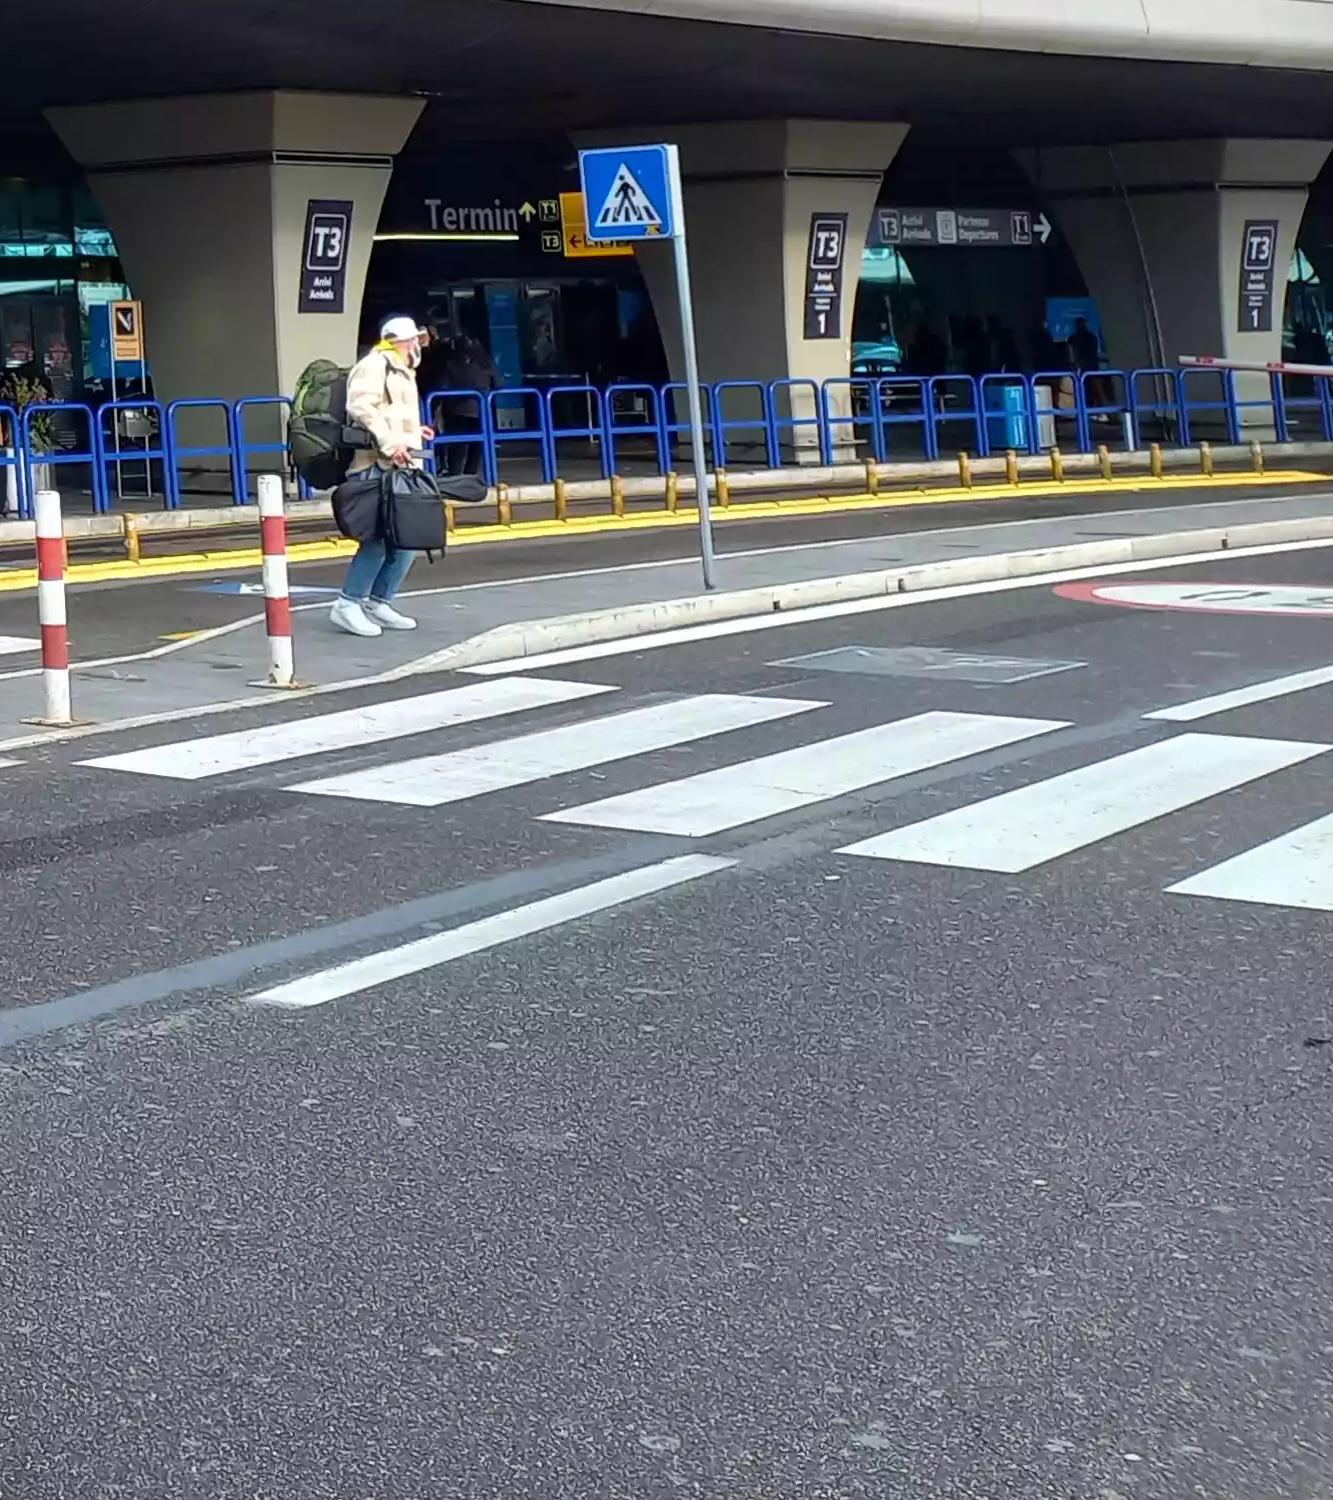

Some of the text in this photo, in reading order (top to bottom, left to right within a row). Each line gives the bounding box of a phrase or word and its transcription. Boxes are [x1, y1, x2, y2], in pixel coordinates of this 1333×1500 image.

[881, 217, 898, 236] T3
[314, 226, 342, 258] T3
[542, 236, 560, 248] T3
[817, 231, 839, 258] T3
[1249, 236, 1271, 260] T3
[817, 312, 826, 334] 1
[1251, 308, 1259, 328] 1
